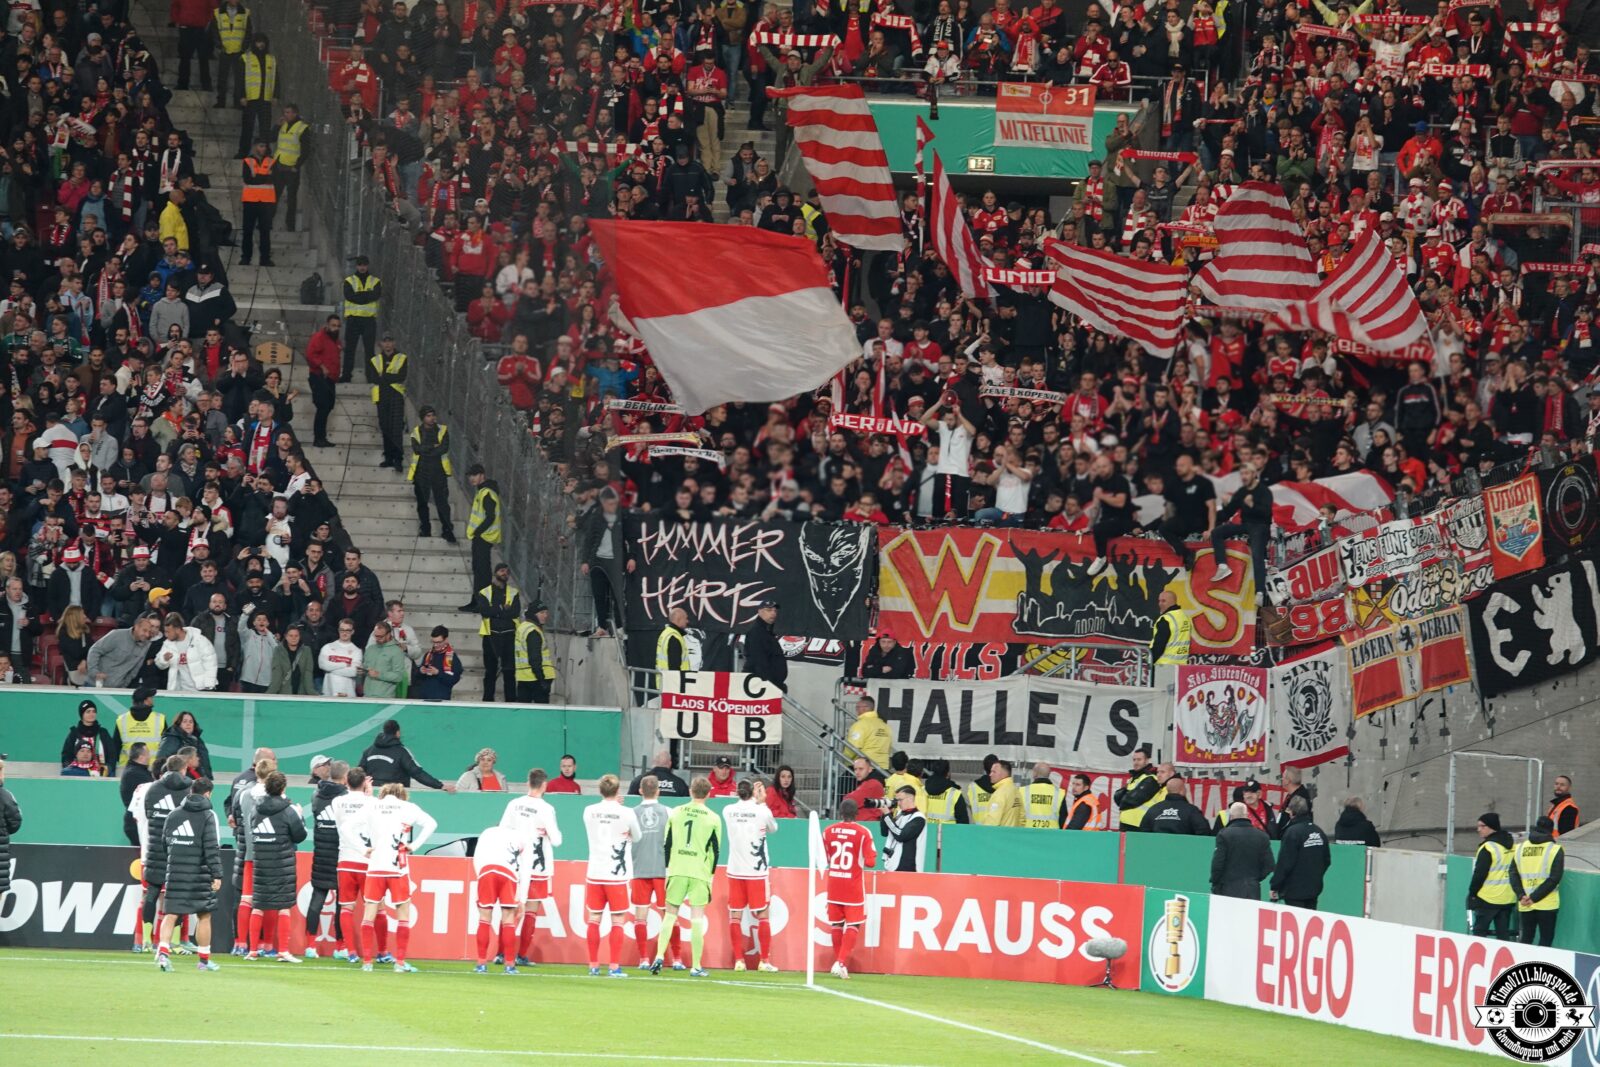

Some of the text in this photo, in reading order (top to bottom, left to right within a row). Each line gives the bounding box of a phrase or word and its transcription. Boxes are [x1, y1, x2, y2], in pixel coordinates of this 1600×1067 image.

[1064, 87, 1090, 106] 31
[999, 119, 1089, 145] MITTELLINIE
[624, 401, 667, 411] BERLIN
[831, 413, 925, 434] BERLIN
[1378, 526, 1408, 558] FÜNF
[1391, 577, 1440, 616] Oder
[1352, 612, 1461, 668] EISERN BERLIN
[680, 670, 767, 698] F C
[1281, 660, 1335, 686] SIXTY
[676, 711, 767, 743] U B
[876, 687, 1059, 750] HALLE
[1286, 723, 1338, 752] NINERS
[1031, 794, 1053, 805] SECURITY
[684, 820, 693, 845] 1
[830, 840, 854, 870] 26
[1255, 907, 1354, 1019] ERGO
